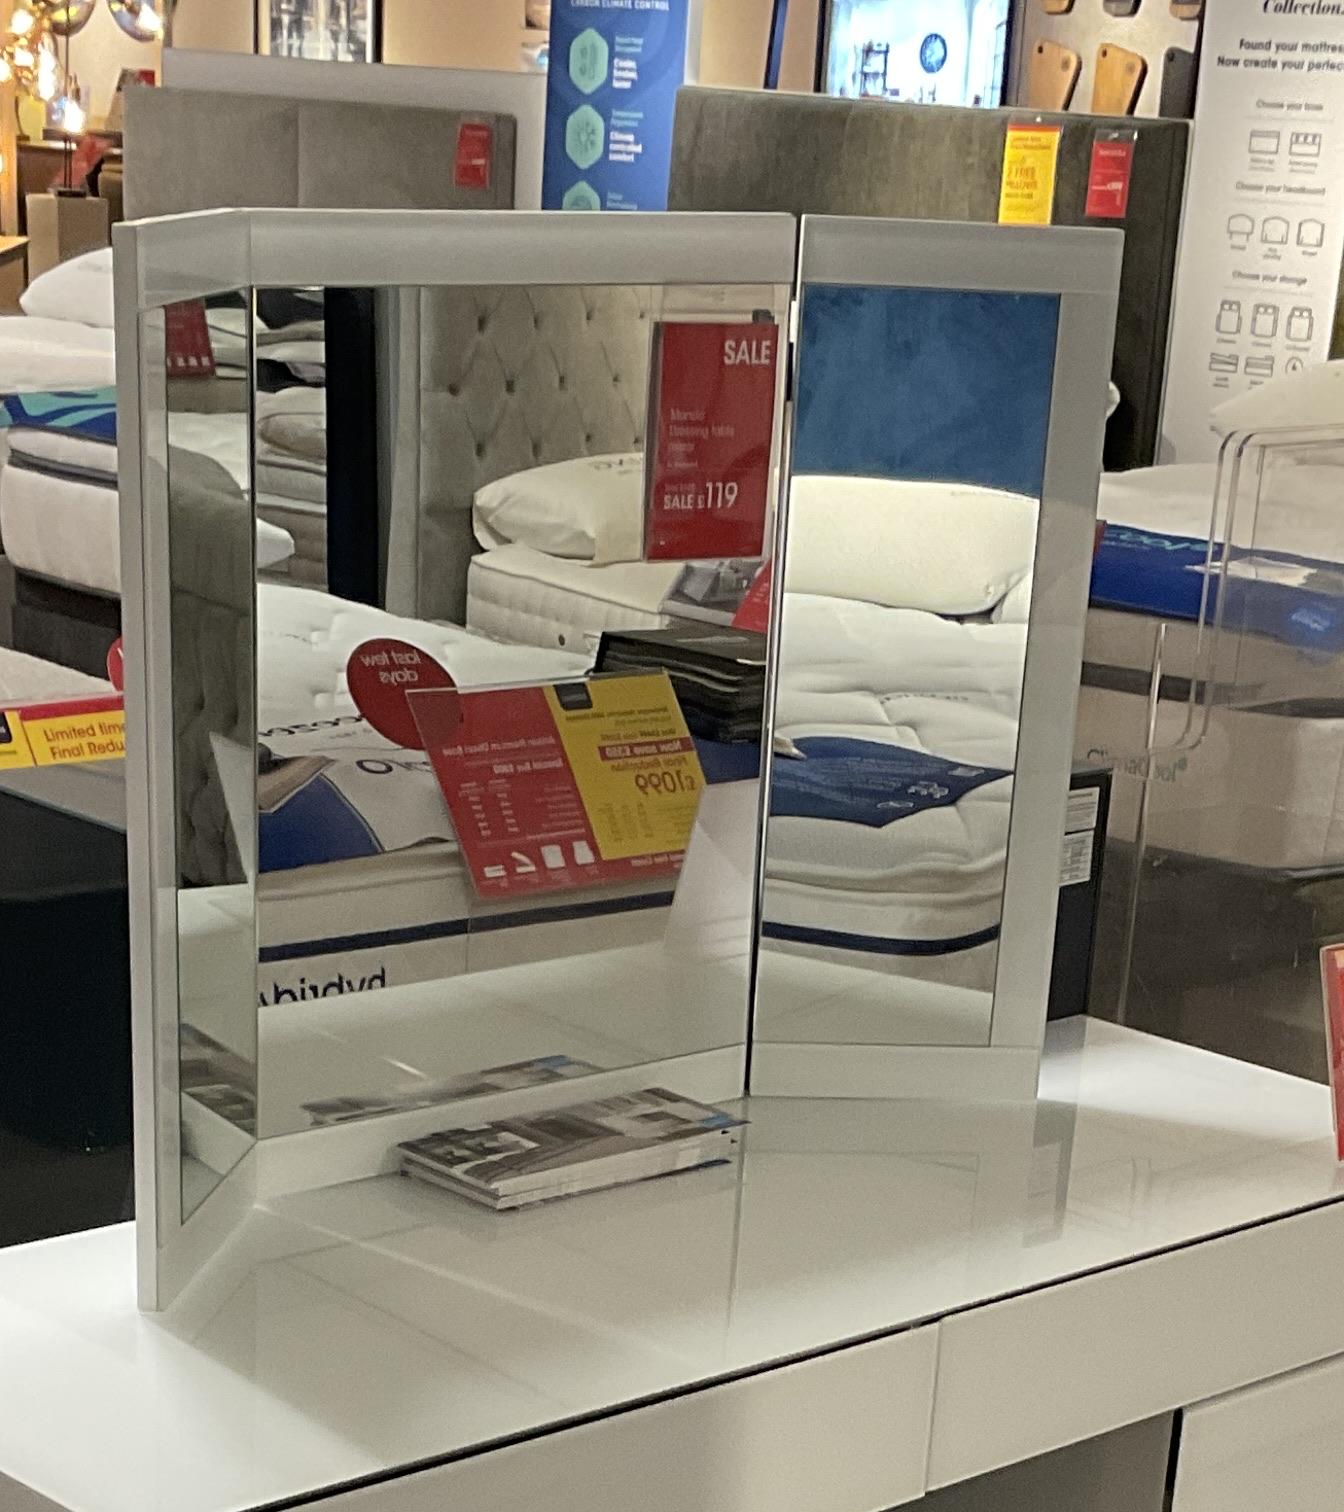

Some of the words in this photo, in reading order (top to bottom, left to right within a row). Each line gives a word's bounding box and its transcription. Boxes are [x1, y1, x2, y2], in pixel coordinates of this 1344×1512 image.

[1239, 38, 1273, 50] Found
[1274, 42, 1299, 54] your
[1216, 55, 1240, 67] Now
[1242, 58, 1279, 70] create
[1281, 60, 1305, 72] your
[723, 338, 772, 367] SALE
[663, 493, 694, 511] SALE
[697, 480, 739, 509] £119
[42, 723, 97, 743] Limited
[51, 743, 86, 761] Final
